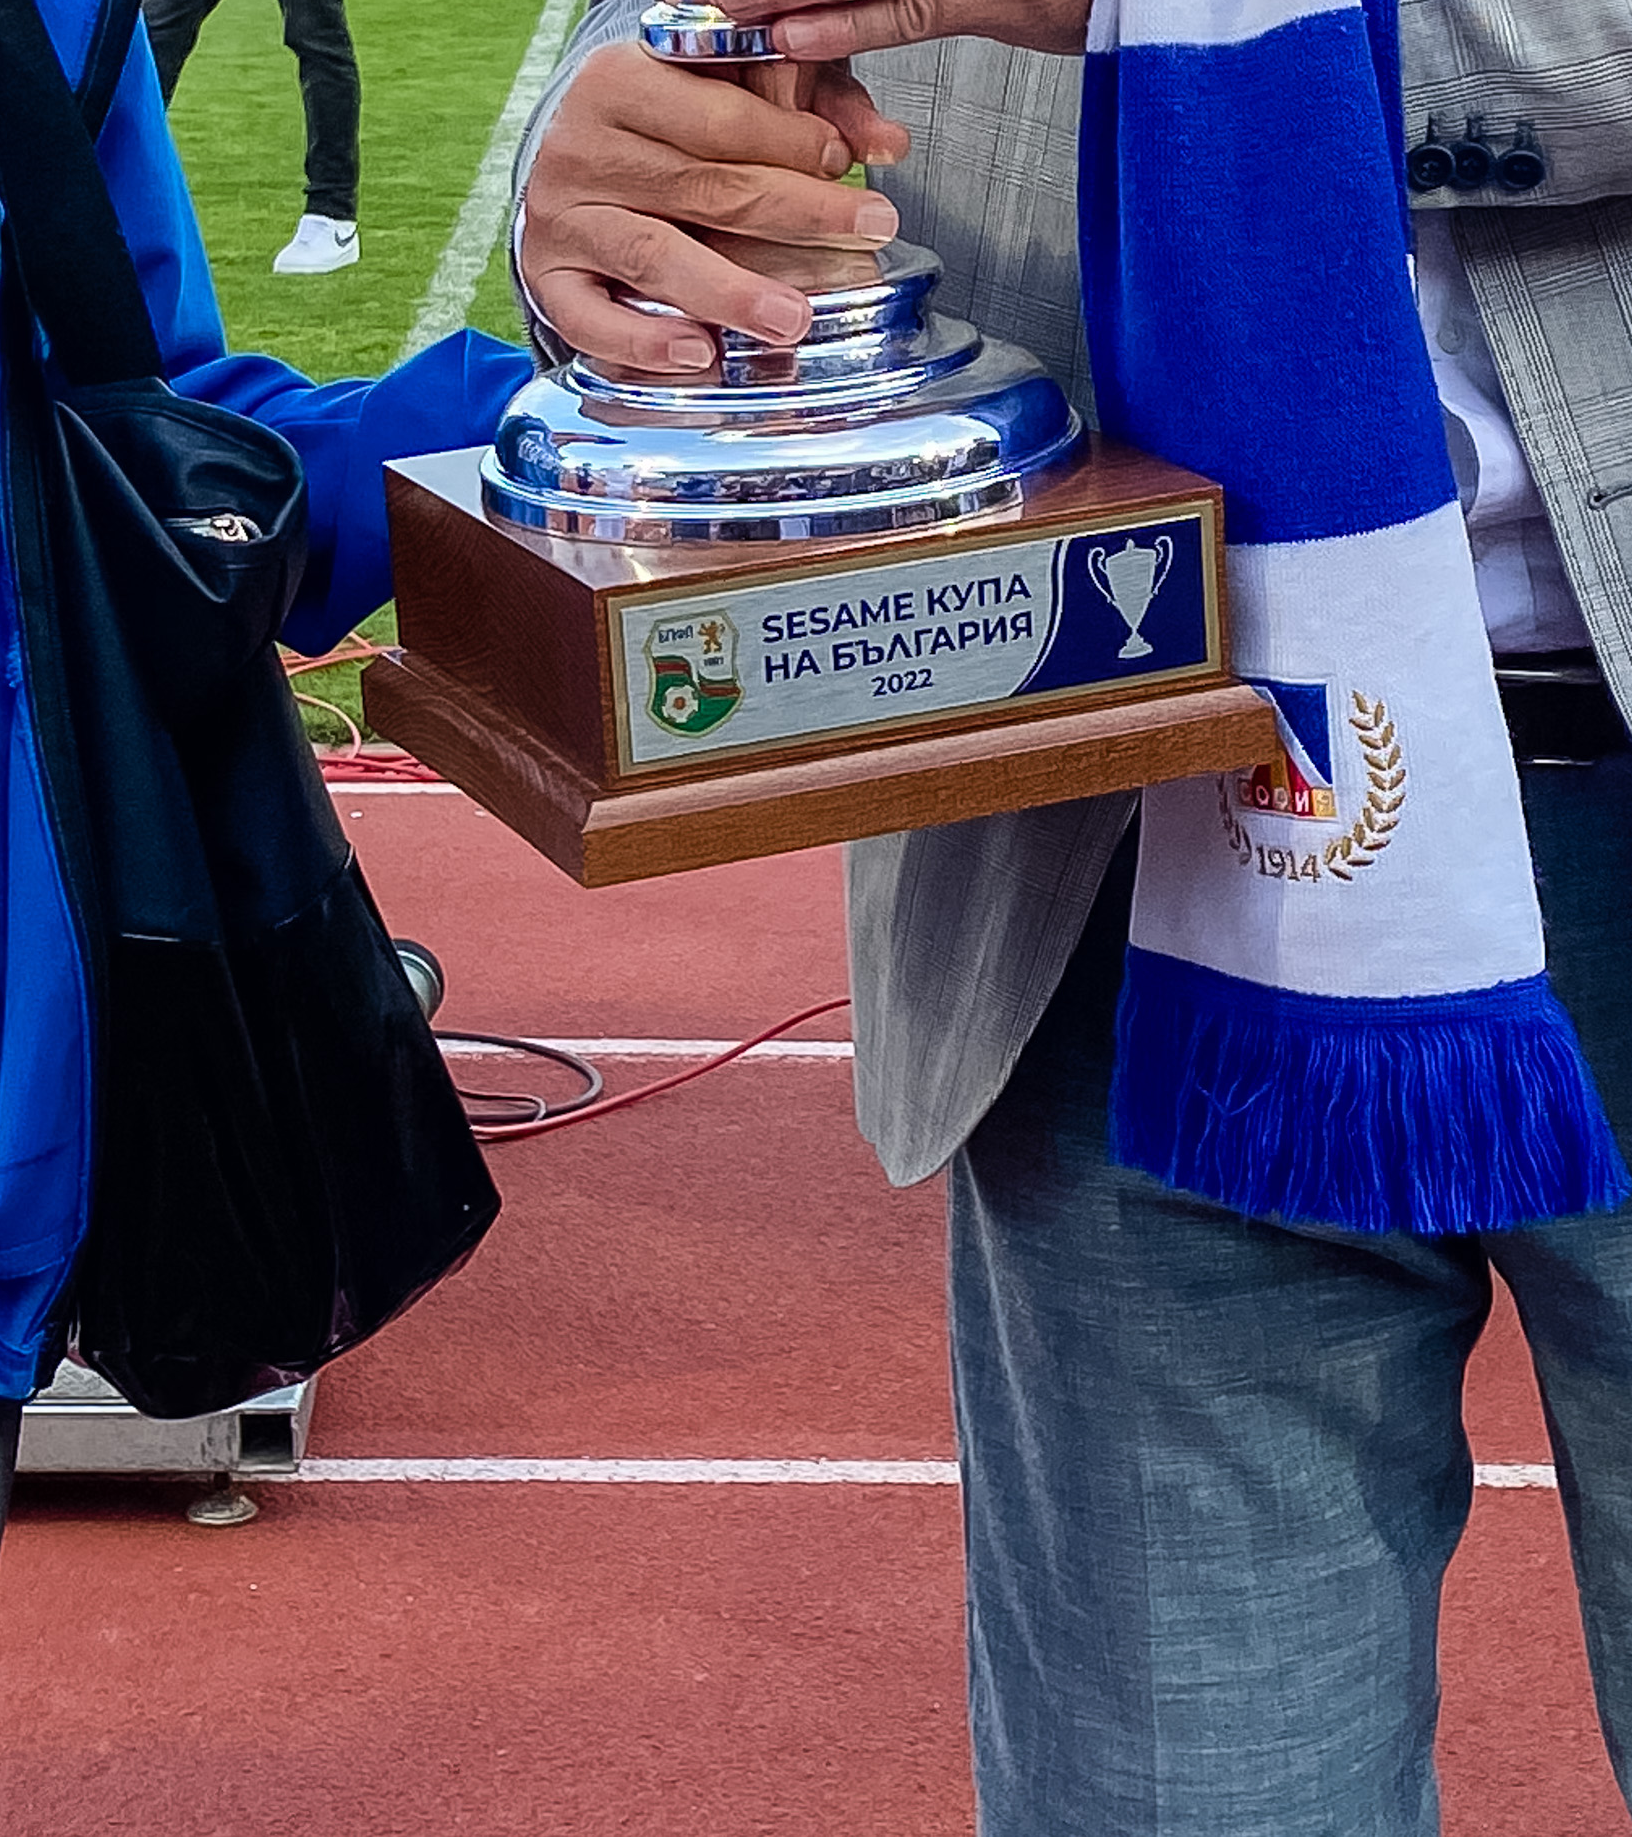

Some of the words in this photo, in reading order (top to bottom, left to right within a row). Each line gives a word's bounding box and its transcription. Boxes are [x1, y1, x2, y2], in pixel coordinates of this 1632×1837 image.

[762, 592, 915, 643] SESAME
[927, 574, 1032, 616] КУПА
[764, 649, 821, 683] НА
[832, 610, 1033, 671] БЪЛГАРИЯ
[871, 668, 934, 697] 2022
[1256, 845, 1322, 883] 1914
